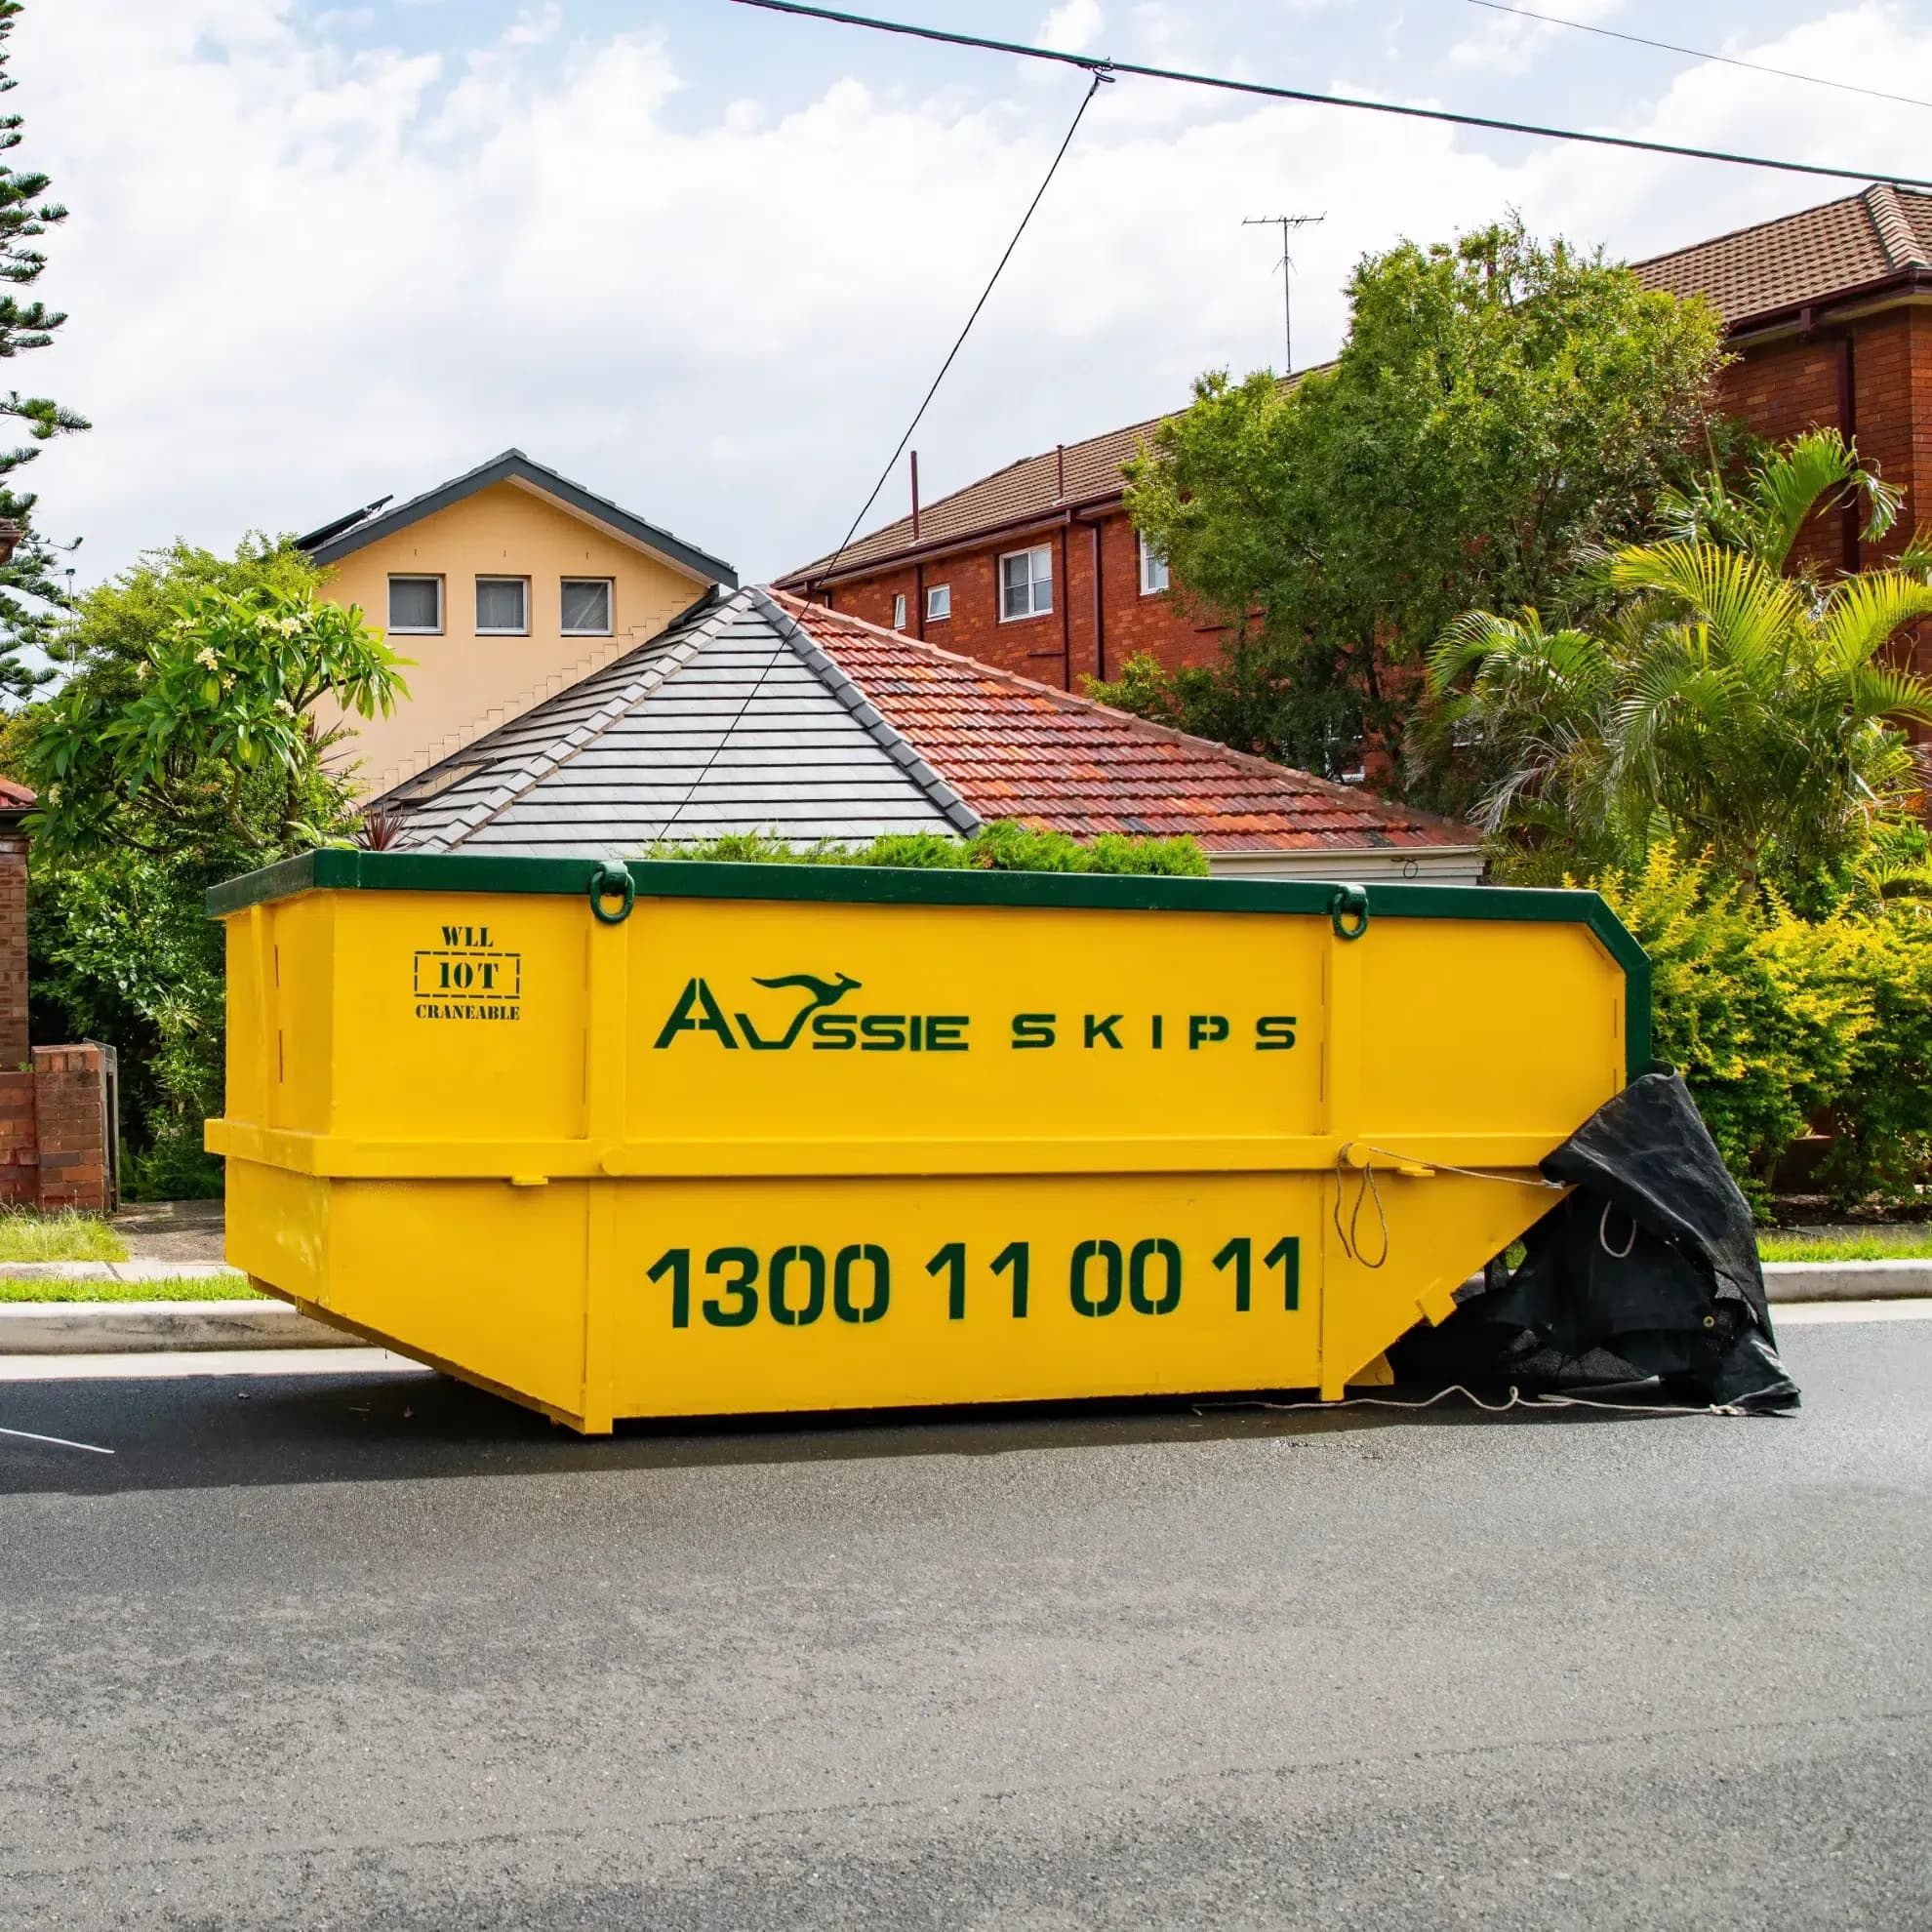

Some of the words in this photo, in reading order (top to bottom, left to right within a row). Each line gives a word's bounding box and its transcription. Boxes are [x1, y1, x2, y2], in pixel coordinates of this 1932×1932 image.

[441, 926, 494, 947] WLL
[438, 962, 499, 989] 10T
[415, 1004, 520, 1021] CRANEABLE
[653, 972, 970, 1052] AUSSIE
[1011, 1013, 1297, 1051] SKIPS
[646, 1243, 891, 1329] 1300
[925, 1241, 1029, 1320] 11
[1069, 1237, 1183, 1318] 00
[1212, 1235, 1301, 1313] 11
